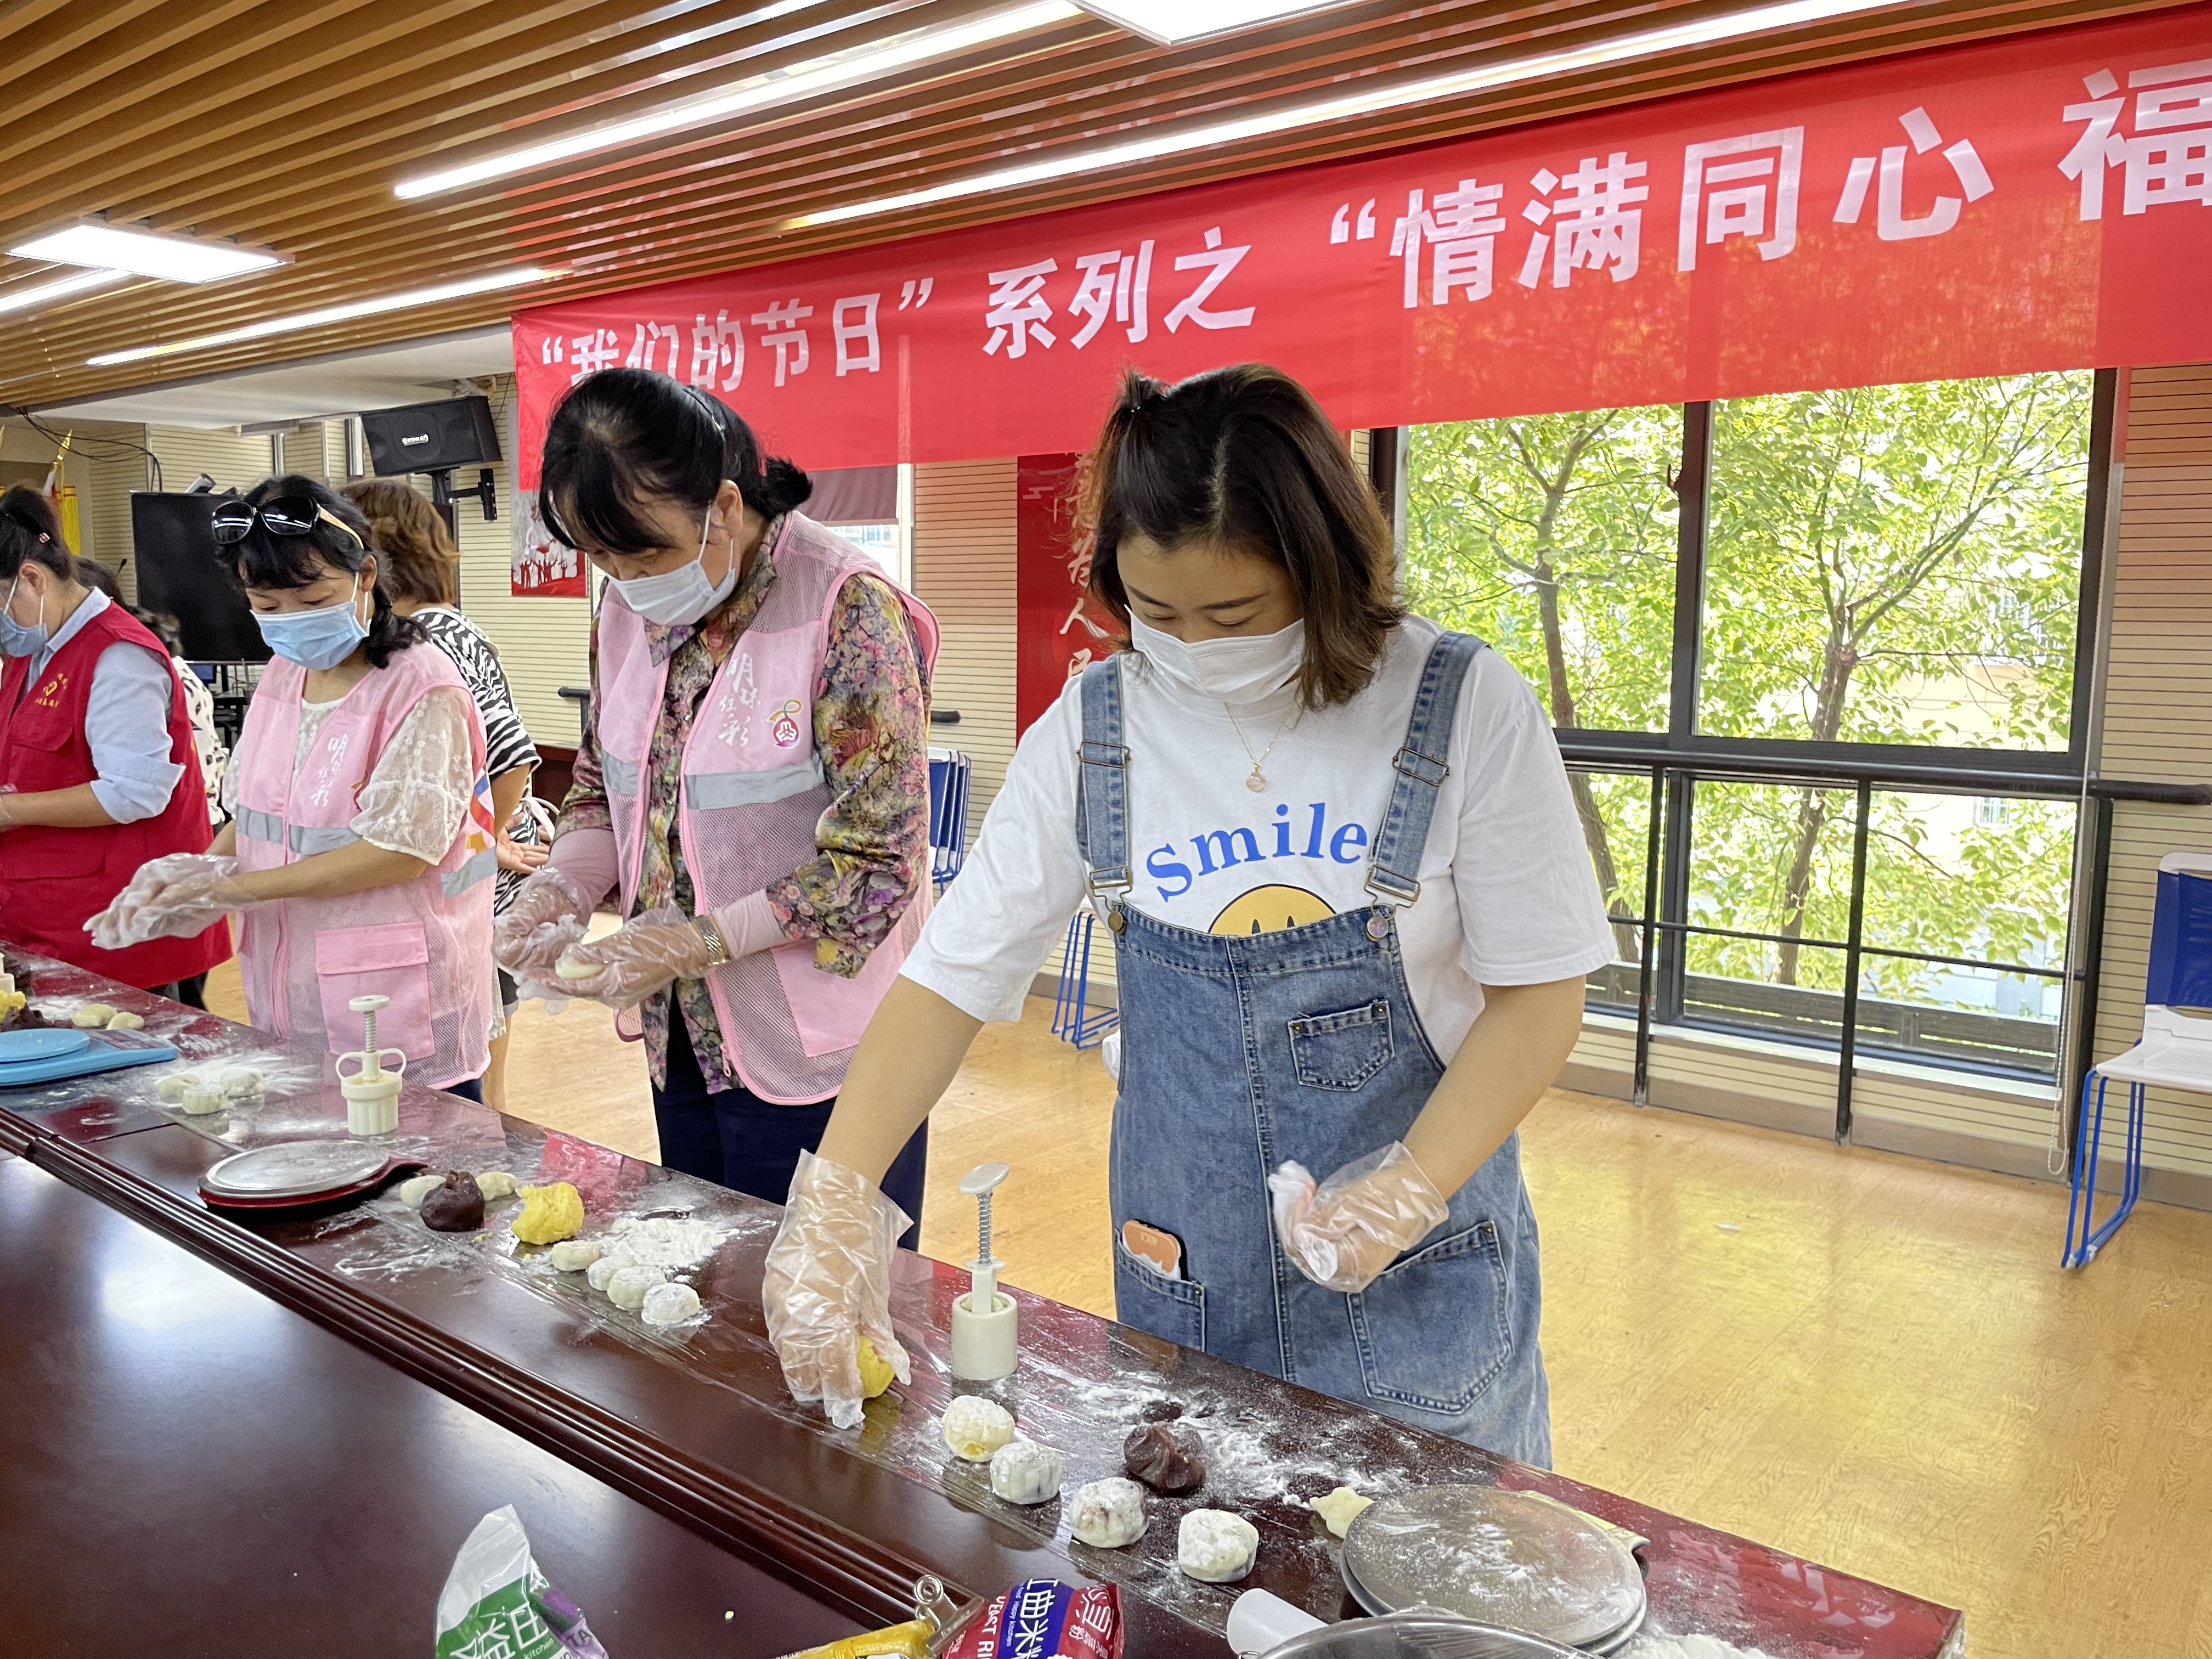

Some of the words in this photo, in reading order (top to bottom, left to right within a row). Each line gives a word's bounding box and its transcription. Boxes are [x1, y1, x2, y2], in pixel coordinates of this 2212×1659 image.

[982, 225, 1257, 359] 系列之
[1329, 105, 1995, 309] “情满同心
[1146, 802, 1368, 902] Smile
[1006, 1621, 1016, 1646] kitchen
[523, 1638, 555, 1659] kitchen
[977, 1640, 994, 1659] RI
